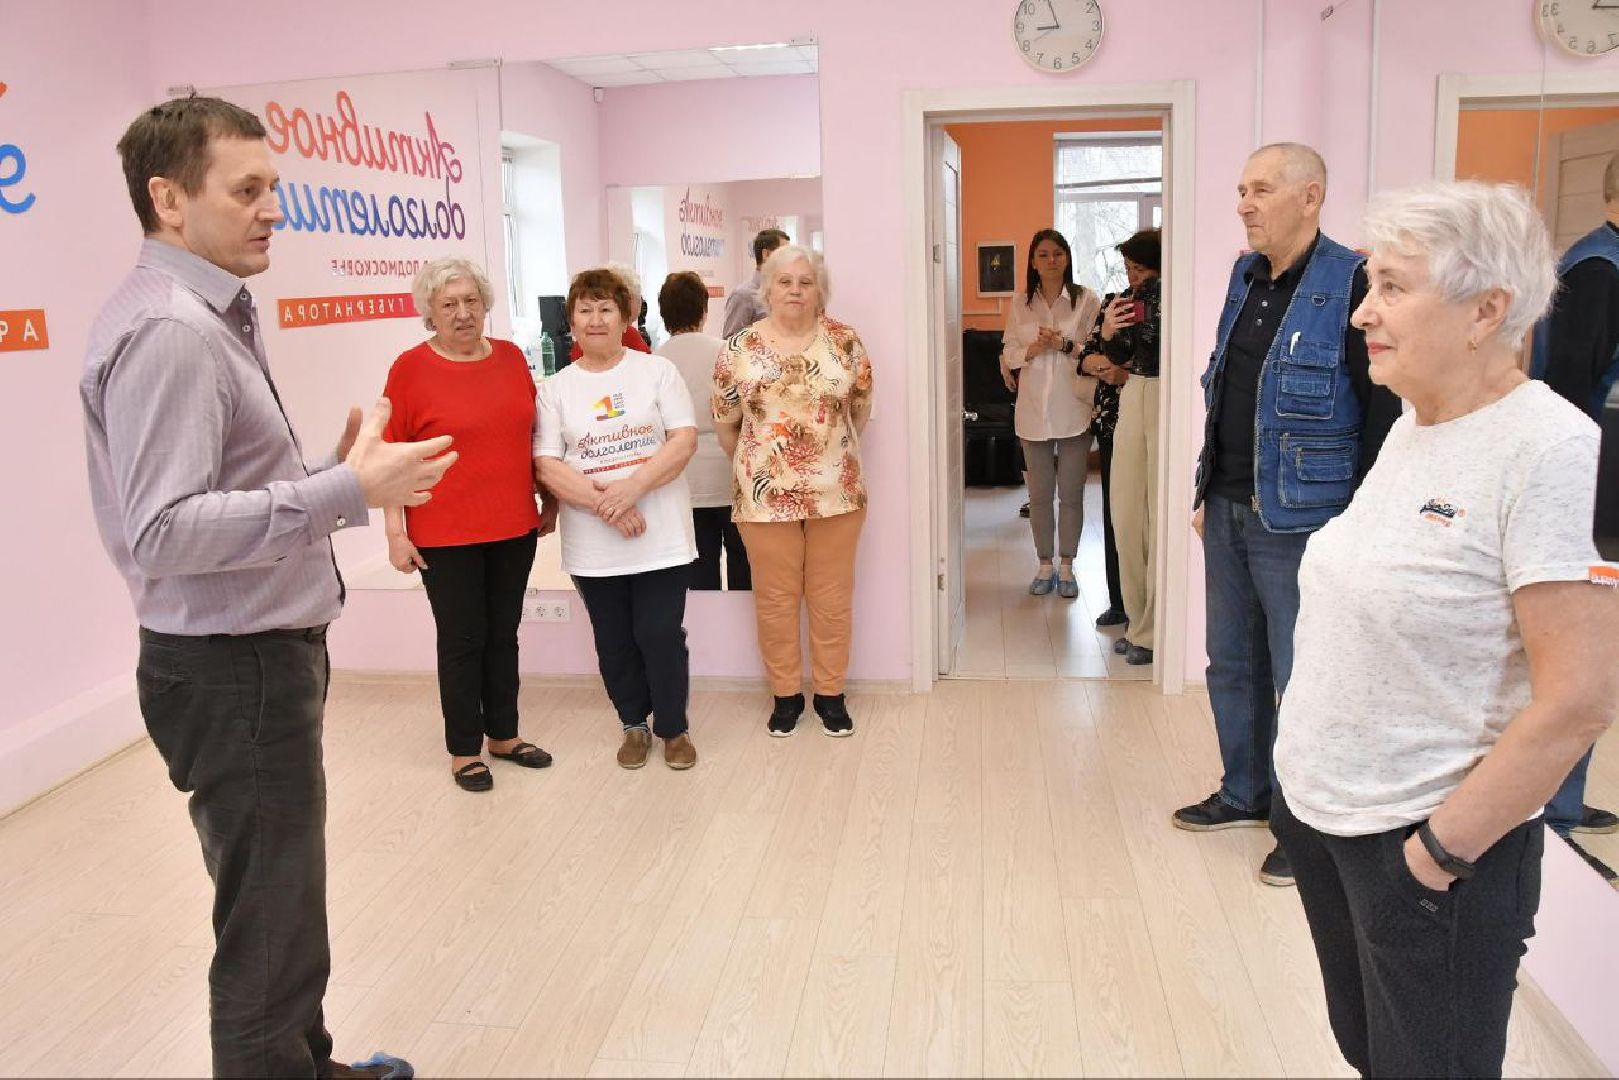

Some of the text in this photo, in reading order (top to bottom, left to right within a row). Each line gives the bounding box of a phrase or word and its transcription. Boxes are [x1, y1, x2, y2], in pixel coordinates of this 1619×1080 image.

[1023, 2, 1036, 16] 10
[1085, 2, 1095, 14] 2
[1015, 21, 1025, 33] 9
[1091, 20, 1100, 32] 3
[1022, 39, 1031, 52] 8
[1084, 39, 1092, 49] 4
[1036, 52, 1044, 65] 7
[1053, 57, 1063, 69] 6
[1071, 52, 1080, 65] 5
[577, 423, 653, 449] Активное
